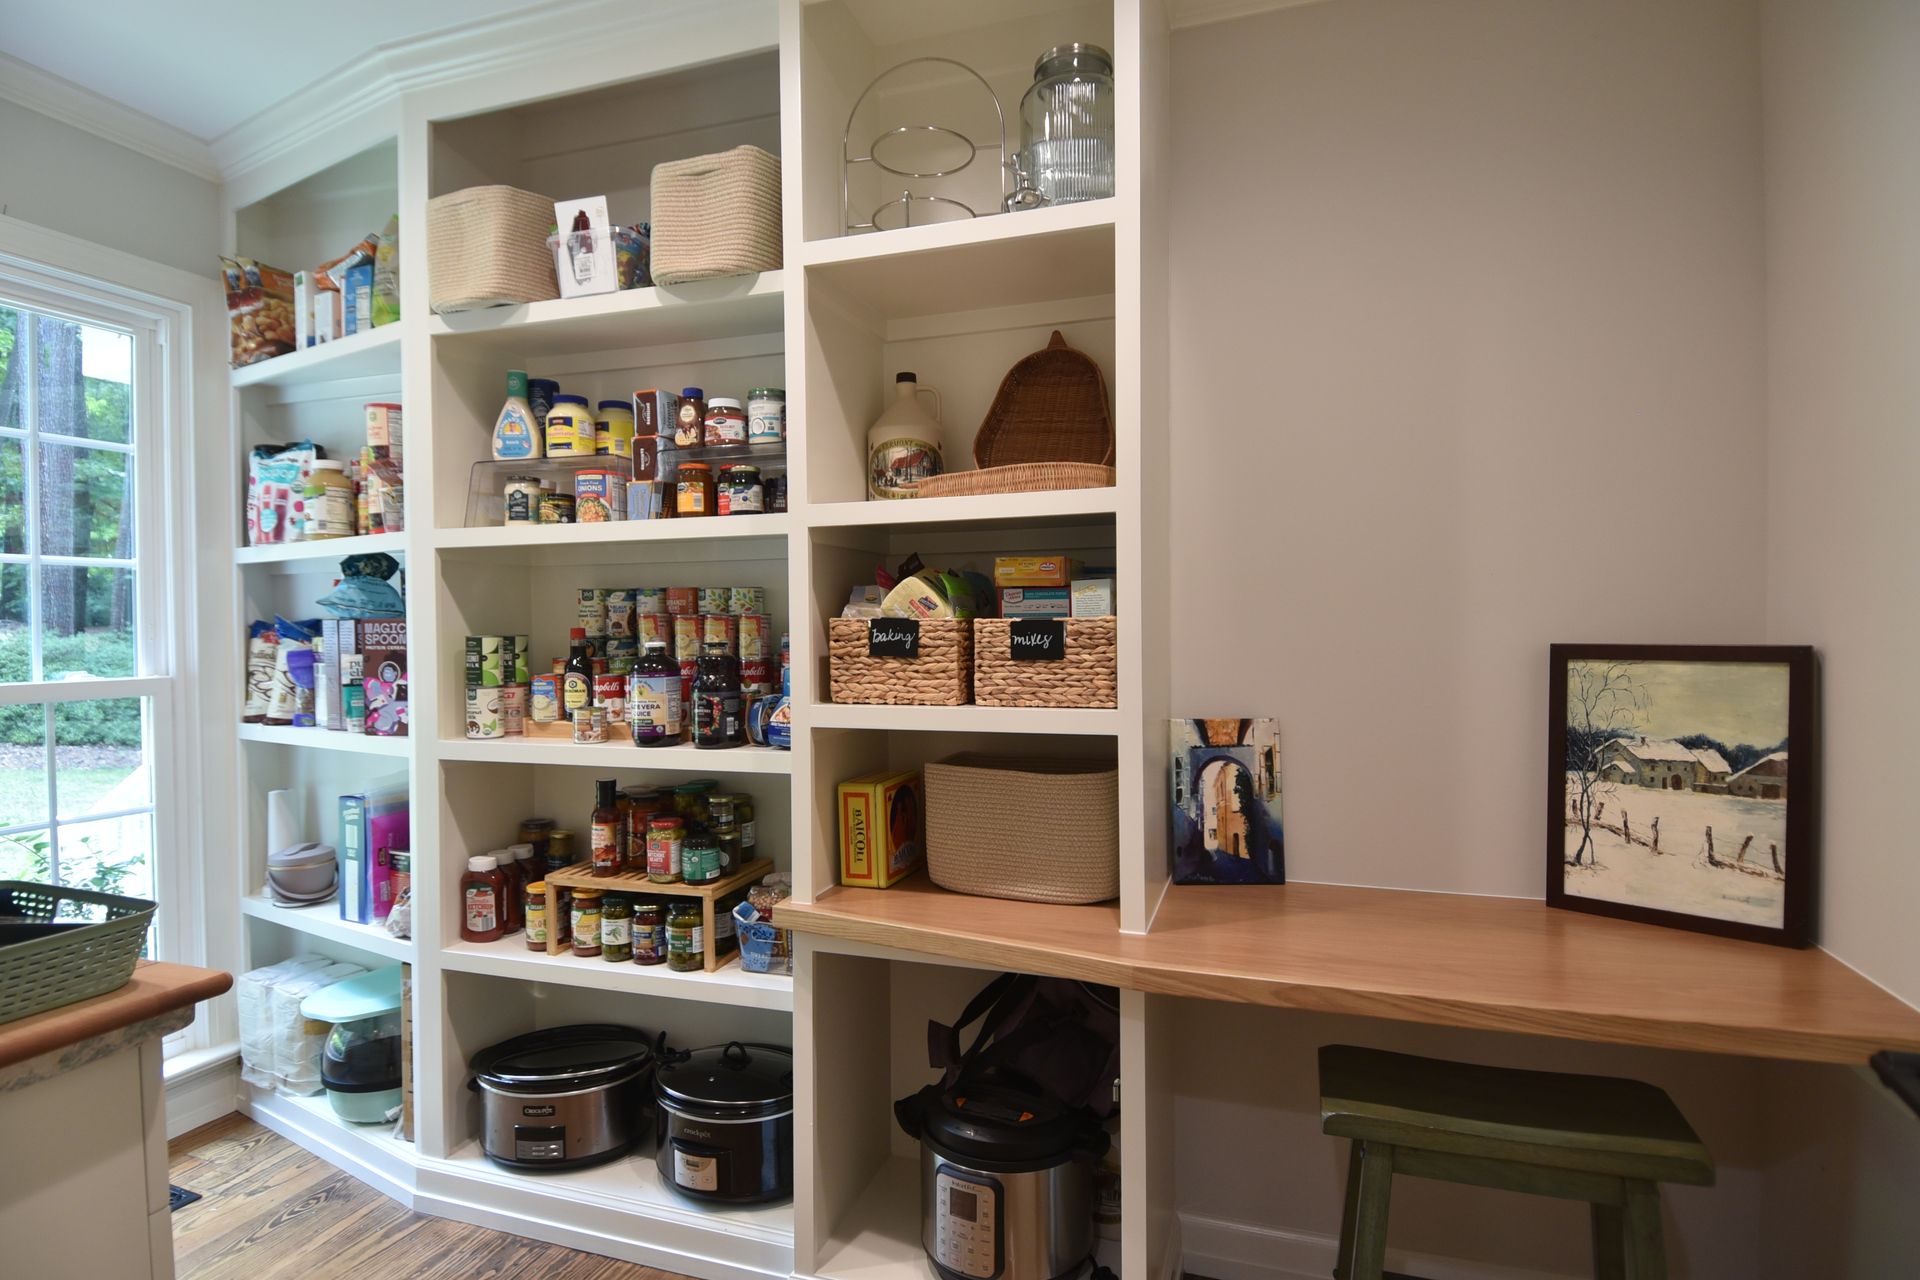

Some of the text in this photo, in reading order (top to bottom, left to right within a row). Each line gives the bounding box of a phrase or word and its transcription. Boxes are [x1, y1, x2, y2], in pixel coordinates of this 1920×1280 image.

[364, 622, 406, 634] MAGIC
[364, 633, 407, 645] SPOON
[872, 627, 915, 649] baking
[1012, 632, 1053, 649] mixes
[593, 681, 620, 692] mpbell's
[854, 809, 866, 862] BAICOLI
